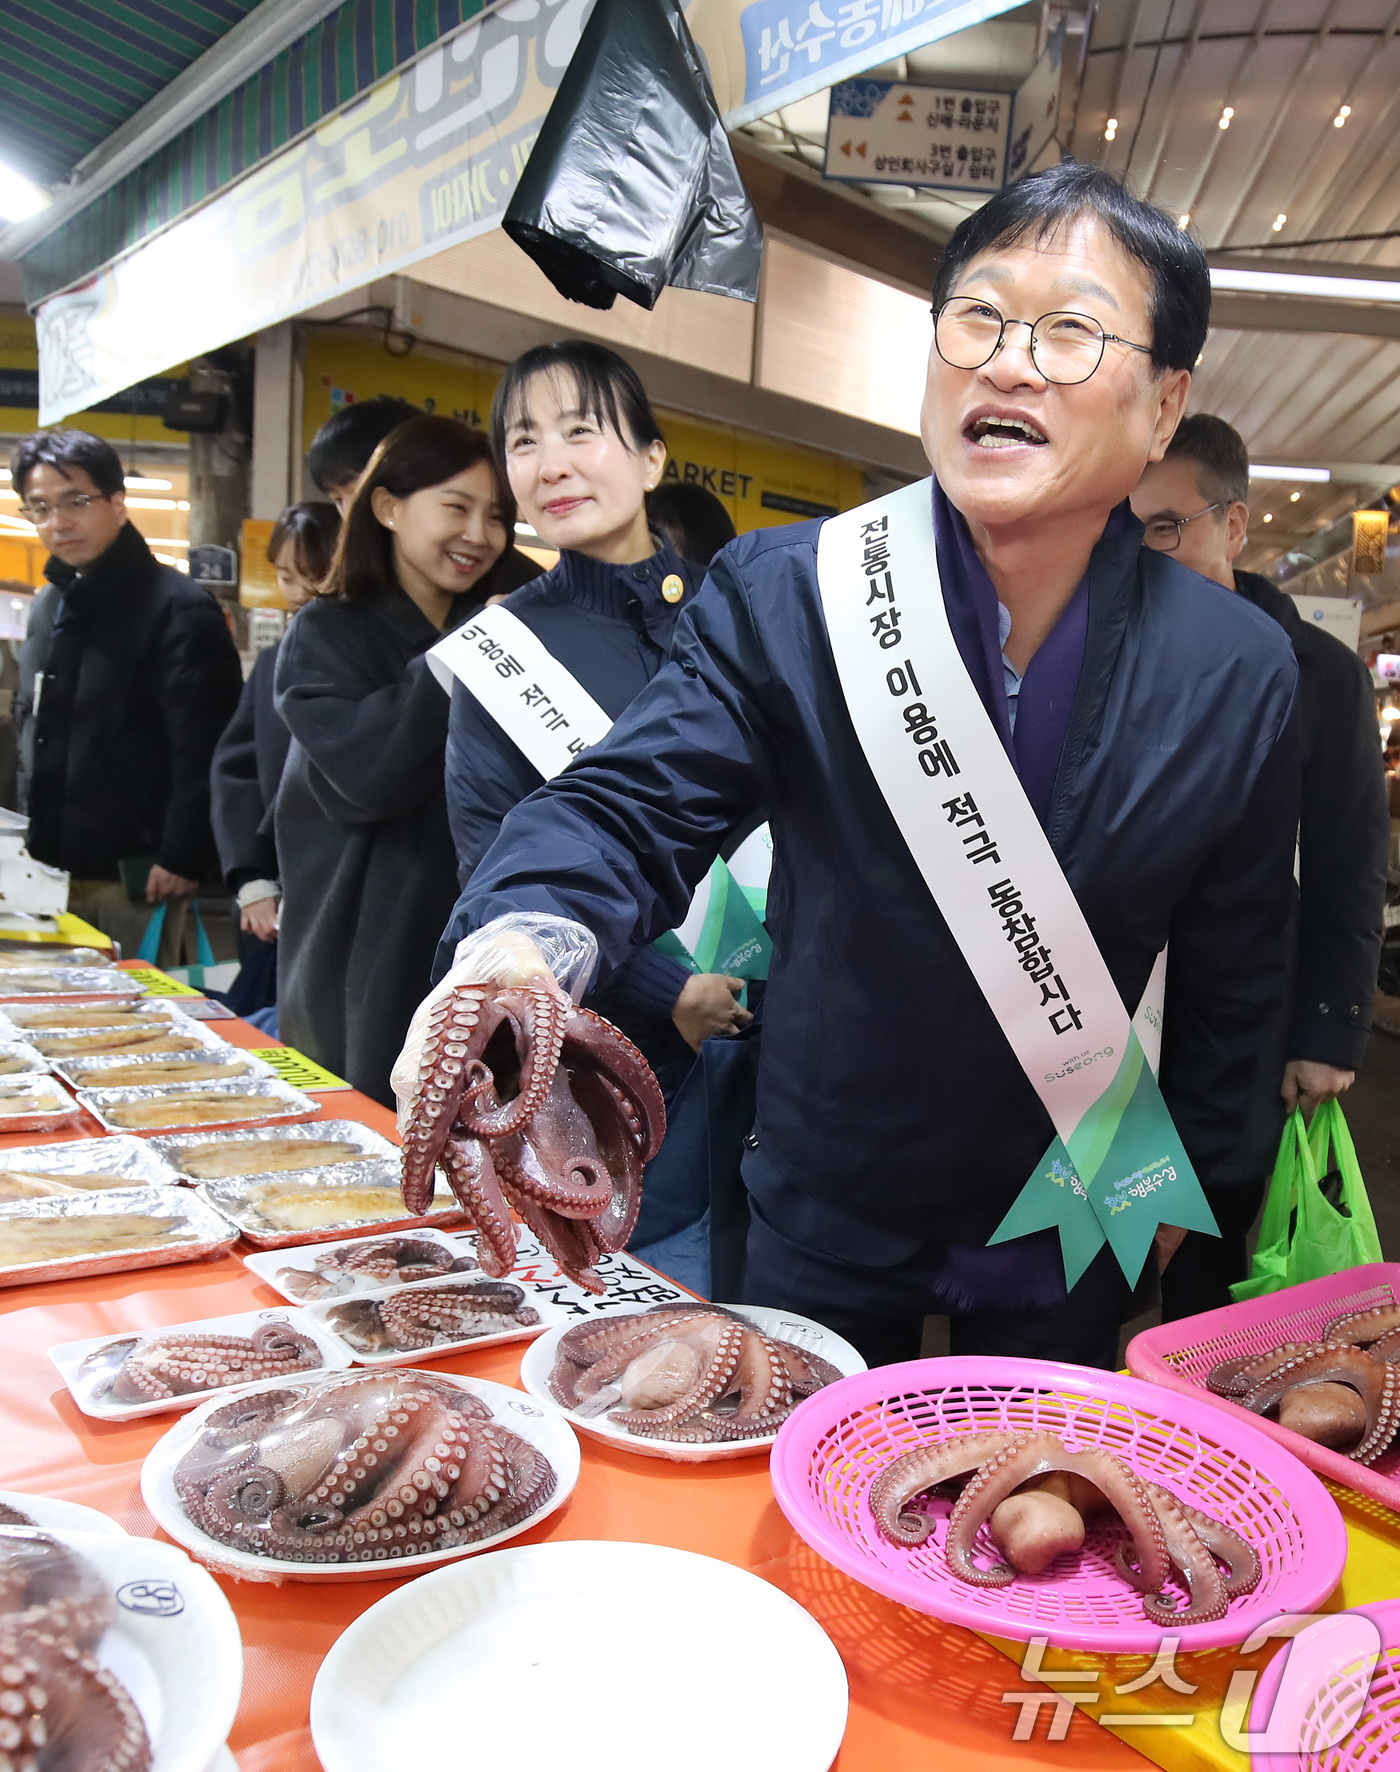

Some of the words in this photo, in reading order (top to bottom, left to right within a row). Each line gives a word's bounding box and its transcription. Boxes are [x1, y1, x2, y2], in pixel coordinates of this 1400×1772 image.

[935, 96, 956, 112] 1번
[960, 98, 1000, 116] 출입구
[930, 143, 951, 159] 3번
[957, 145, 996, 164] 출입구
[663, 458, 753, 498] ARKET
[200, 562, 223, 578] 24
[461, 625, 526, 678] 이용에
[520, 683, 570, 731] 적극
[860, 514, 904, 650] 전통시장
[886, 658, 961, 777] 이용에
[941, 795, 1002, 866] 적극
[987, 878, 1082, 1036] 동참합시다
[1044, 1046, 1114, 1083] Suseong
[1062, 1053, 1081, 1067] with
[1081, 1049, 1091, 1058] us
[1127, 1165, 1178, 1198] 행복수성
